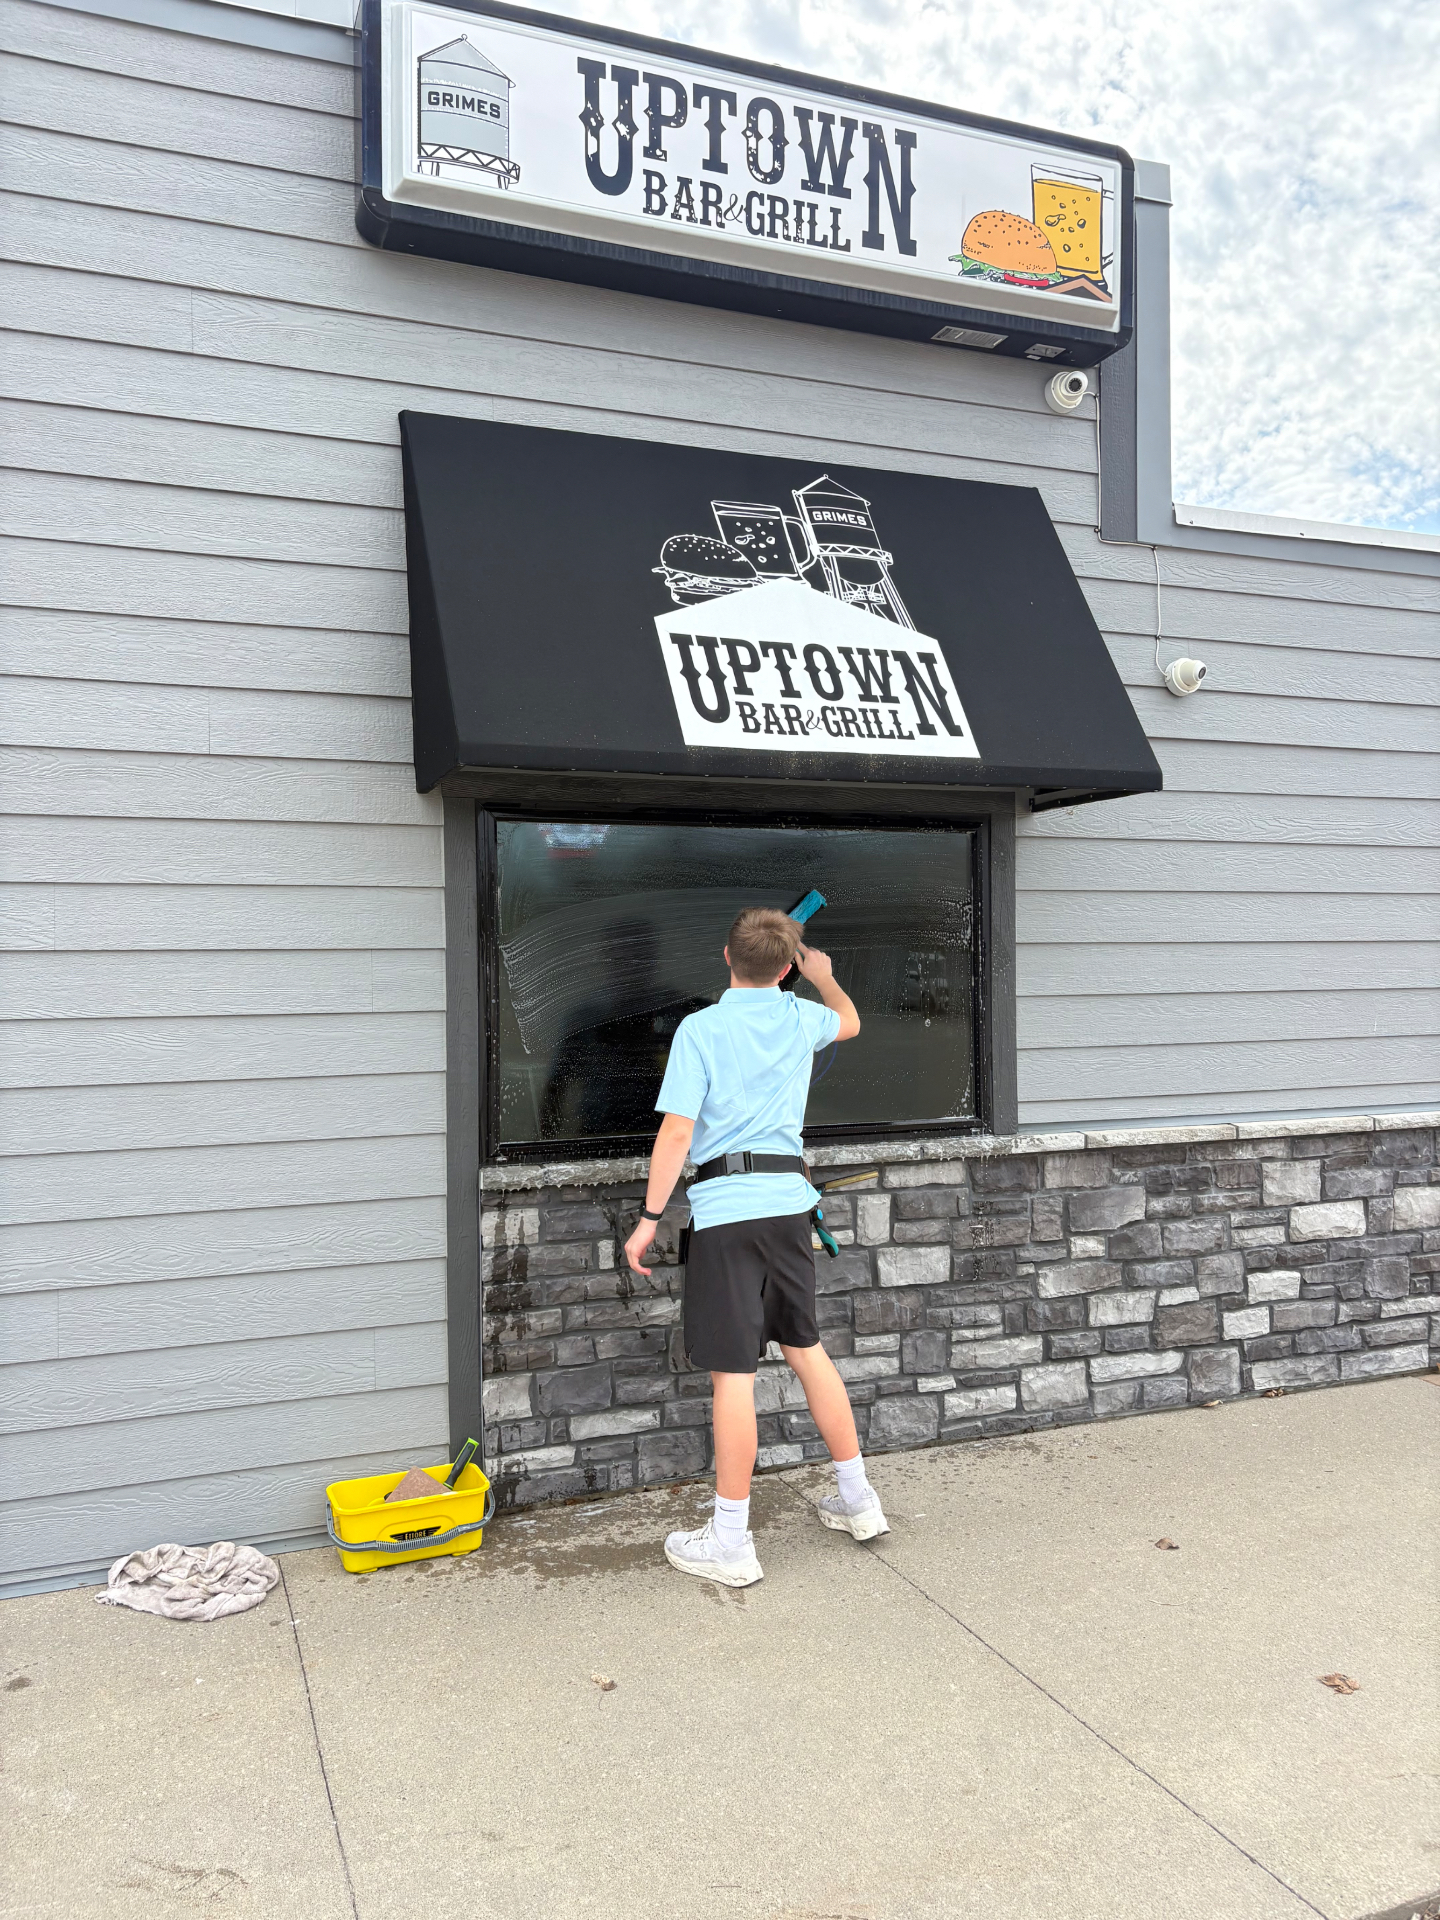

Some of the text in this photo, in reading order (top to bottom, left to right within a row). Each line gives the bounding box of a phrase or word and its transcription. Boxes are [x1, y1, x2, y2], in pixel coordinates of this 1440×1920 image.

[427, 90, 501, 120] GRIMES
[577, 56, 918, 257] UPTOWN
[812, 510, 868, 526] GRIMES
[669, 632, 964, 737] UPTOWN
